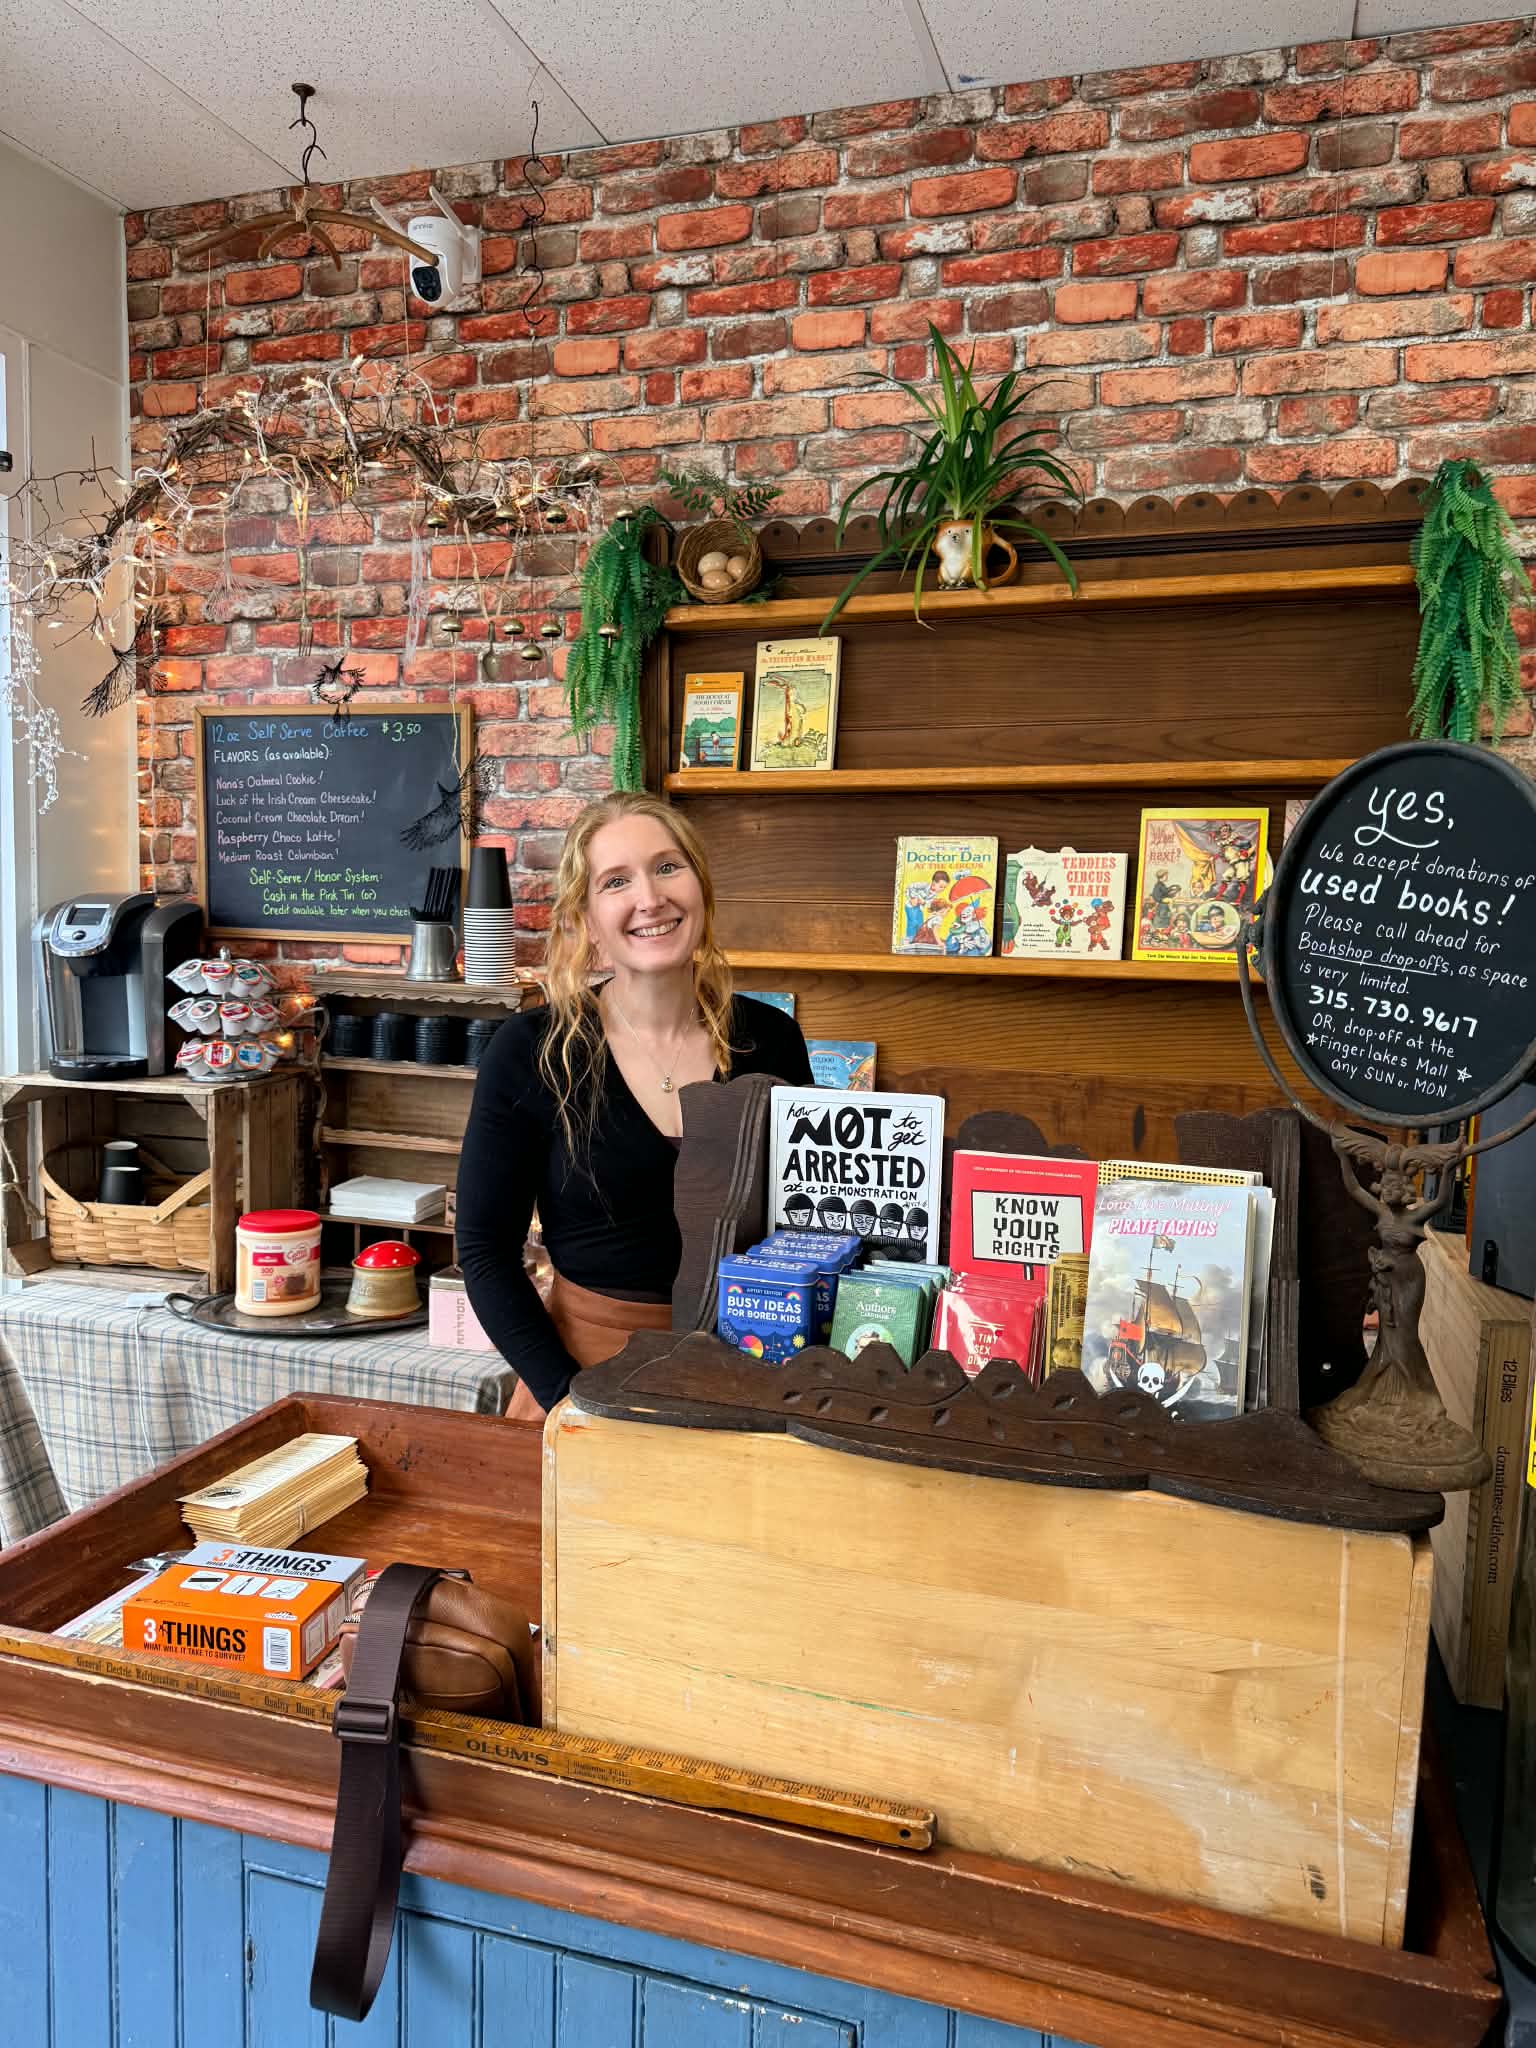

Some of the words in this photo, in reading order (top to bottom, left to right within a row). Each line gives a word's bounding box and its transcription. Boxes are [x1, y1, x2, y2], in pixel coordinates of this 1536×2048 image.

[212, 724, 224, 743] 12
[248, 721, 276, 740] Self
[279, 722, 312, 740] Serve
[323, 720, 368, 739] Coffee
[214, 750, 259, 763] FLAVORS
[265, 746, 280, 761] (as
[216, 776, 244, 790] Nana's
[247, 774, 282, 788] Oatmeal
[286, 770, 323, 785] Cookie!
[216, 793, 236, 806] Luck
[239, 793, 248, 805] of
[252, 793, 265, 806] the
[268, 791, 286, 805] Irish
[288, 791, 316, 805] Cream
[321, 790, 376, 804] Cheesecake!
[216, 810, 251, 824] Coconut
[255, 811, 282, 823] Cream
[287, 808, 327, 823] Chocolate
[330, 810, 364, 823] Dream!
[217, 829, 268, 848] Raspberry
[272, 830, 302, 843] Choco
[219, 851, 250, 864] Medium
[255, 849, 283, 861] Roast
[288, 848, 339, 861] Columbian!
[907, 851, 957, 863] Doctor
[960, 850, 991, 862] Dan
[1062, 857, 1116, 869] TEDDIES
[250, 867, 302, 885] Self-Serve
[314, 868, 341, 882] Honor
[1066, 870, 1111, 883] CIRCUS
[1319, 843, 1344, 863] We
[1353, 851, 1421, 881] accept
[1425, 855, 1510, 887] donations
[1514, 874, 1536, 891] of
[263, 888, 286, 902] Cash
[290, 889, 298, 901] in
[301, 887, 315, 901] the
[320, 888, 338, 901] Pink
[340, 888, 355, 901] Tin
[361, 888, 376, 901] (or)
[1067, 885, 1109, 897] TRAIN
[1300, 868, 1383, 905] used
[1397, 879, 1516, 926] books!
[263, 903, 290, 915] Credit
[293, 904, 325, 916] available
[330, 904, 348, 916] later
[351, 904, 370, 915] when
[373, 907, 386, 918] you
[1304, 903, 1362, 935] Please
[1375, 916, 1407, 941] call
[1415, 925, 1469, 951] ahead
[1474, 934, 1501, 956] for
[1298, 931, 1373, 964] Bookshop
[1458, 963, 1477, 978] as
[1480, 967, 1529, 989] space
[1299, 959, 1313, 975] is
[1317, 966, 1349, 987] very
[1359, 971, 1411, 995] limited.
[1312, 1012, 1336, 1031] OR,
[1406, 1034, 1425, 1049] at
[1430, 1038, 1456, 1059] the
[1318, 1034, 1409, 1069] Fingerlakes
[1416, 1052, 1449, 1078] Mall
[1331, 1057, 1358, 1079] any
[1364, 1066, 1396, 1085] SUN
[1396, 1078, 1410, 1089] or
[1413, 1078, 1448, 1099] MON
[786, 1102, 821, 1120] how
[893, 1111, 923, 1129] to
[888, 1130, 927, 1151] get
[782, 1149, 926, 1189] ARRESTED
[783, 1182, 803, 1193] at
[806, 1185, 818, 1194] a
[820, 1185, 918, 1201] DEMONSTRATION
[995, 1197, 1060, 1217] KNOW
[993, 1217, 1060, 1244] YOUR
[1108, 1218, 1158, 1236] PIRATE
[1159, 1219, 1217, 1237] TACTICS
[992, 1240, 1060, 1260] RIGHTS
[727, 1295, 760, 1309] BUSY
[764, 1300, 802, 1314] IDEAS
[856, 1301, 897, 1314] Authors
[727, 1307, 745, 1317] FOR
[747, 1310, 778, 1321] BORED
[780, 1314, 802, 1324] KIDS
[978, 1333, 997, 1345] TINY
[974, 1344, 991, 1355] SEX
[1503, 1360, 1518, 1371] 12
[213, 1548, 236, 1562] 3
[238, 1551, 332, 1573] THINGS
[143, 1617, 157, 1642] 3
[162, 1620, 247, 1653] THINGS
[143, 1642, 161, 1651] WHAT
[187, 1648, 203, 1656] TAKE
[214, 1651, 246, 1661] SURVIVE?
[465, 1738, 549, 1766] OLUM'S
